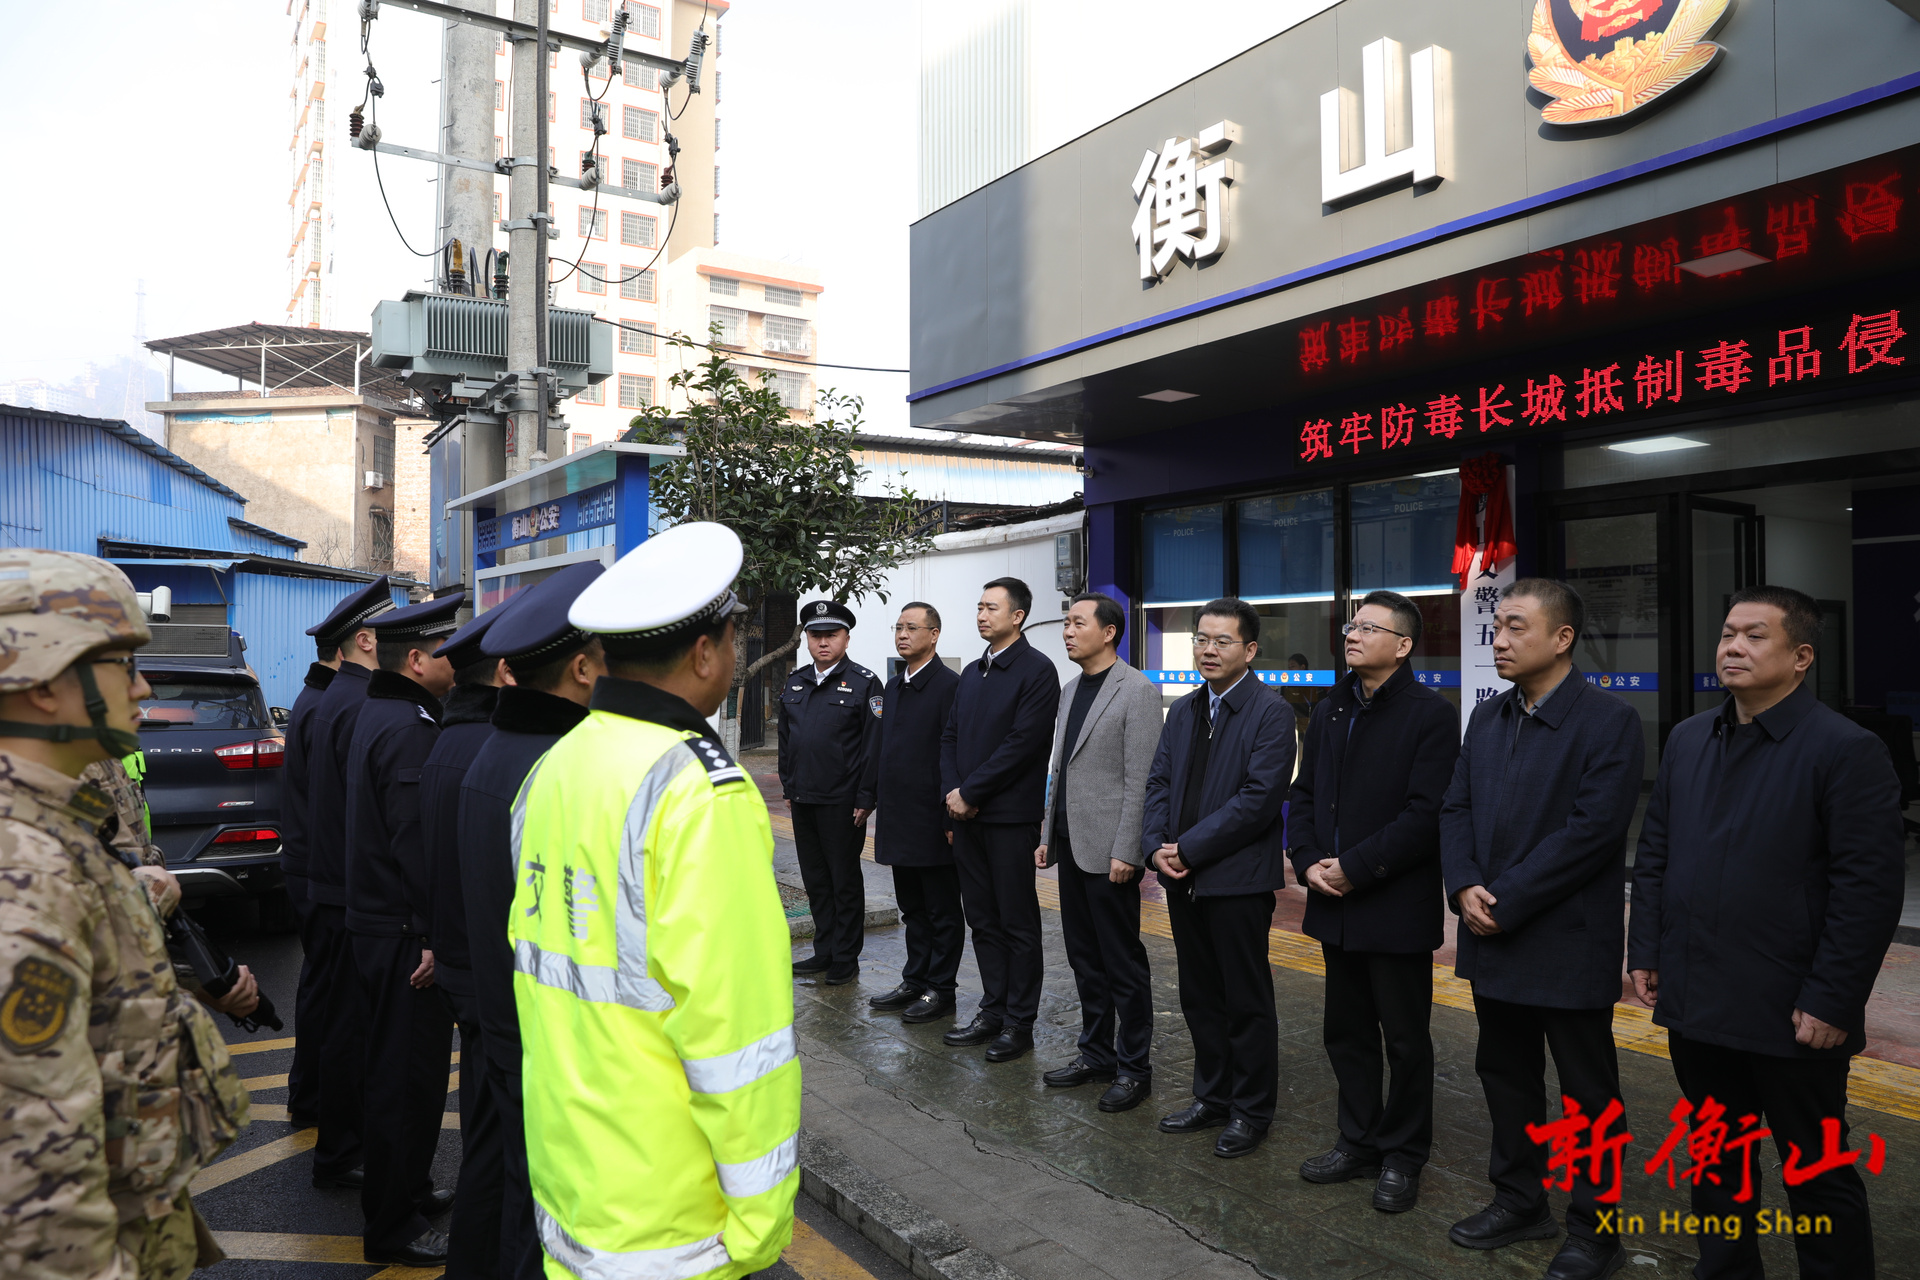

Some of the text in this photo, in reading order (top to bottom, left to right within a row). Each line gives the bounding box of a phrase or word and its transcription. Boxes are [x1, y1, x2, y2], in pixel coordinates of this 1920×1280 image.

[1131, 36, 1451, 279] 衡山
[1300, 310, 1907, 462] 筑牢防毒长城抵制毒品侵
[1394, 501, 1424, 513] POLICE
[1273, 517, 1299, 528] POLICE
[1173, 527, 1194, 537] POLICE
[1293, 673, 1313, 682] 公安
[1418, 673, 1442, 683] 公安
[1615, 675, 1641, 687] 公安
